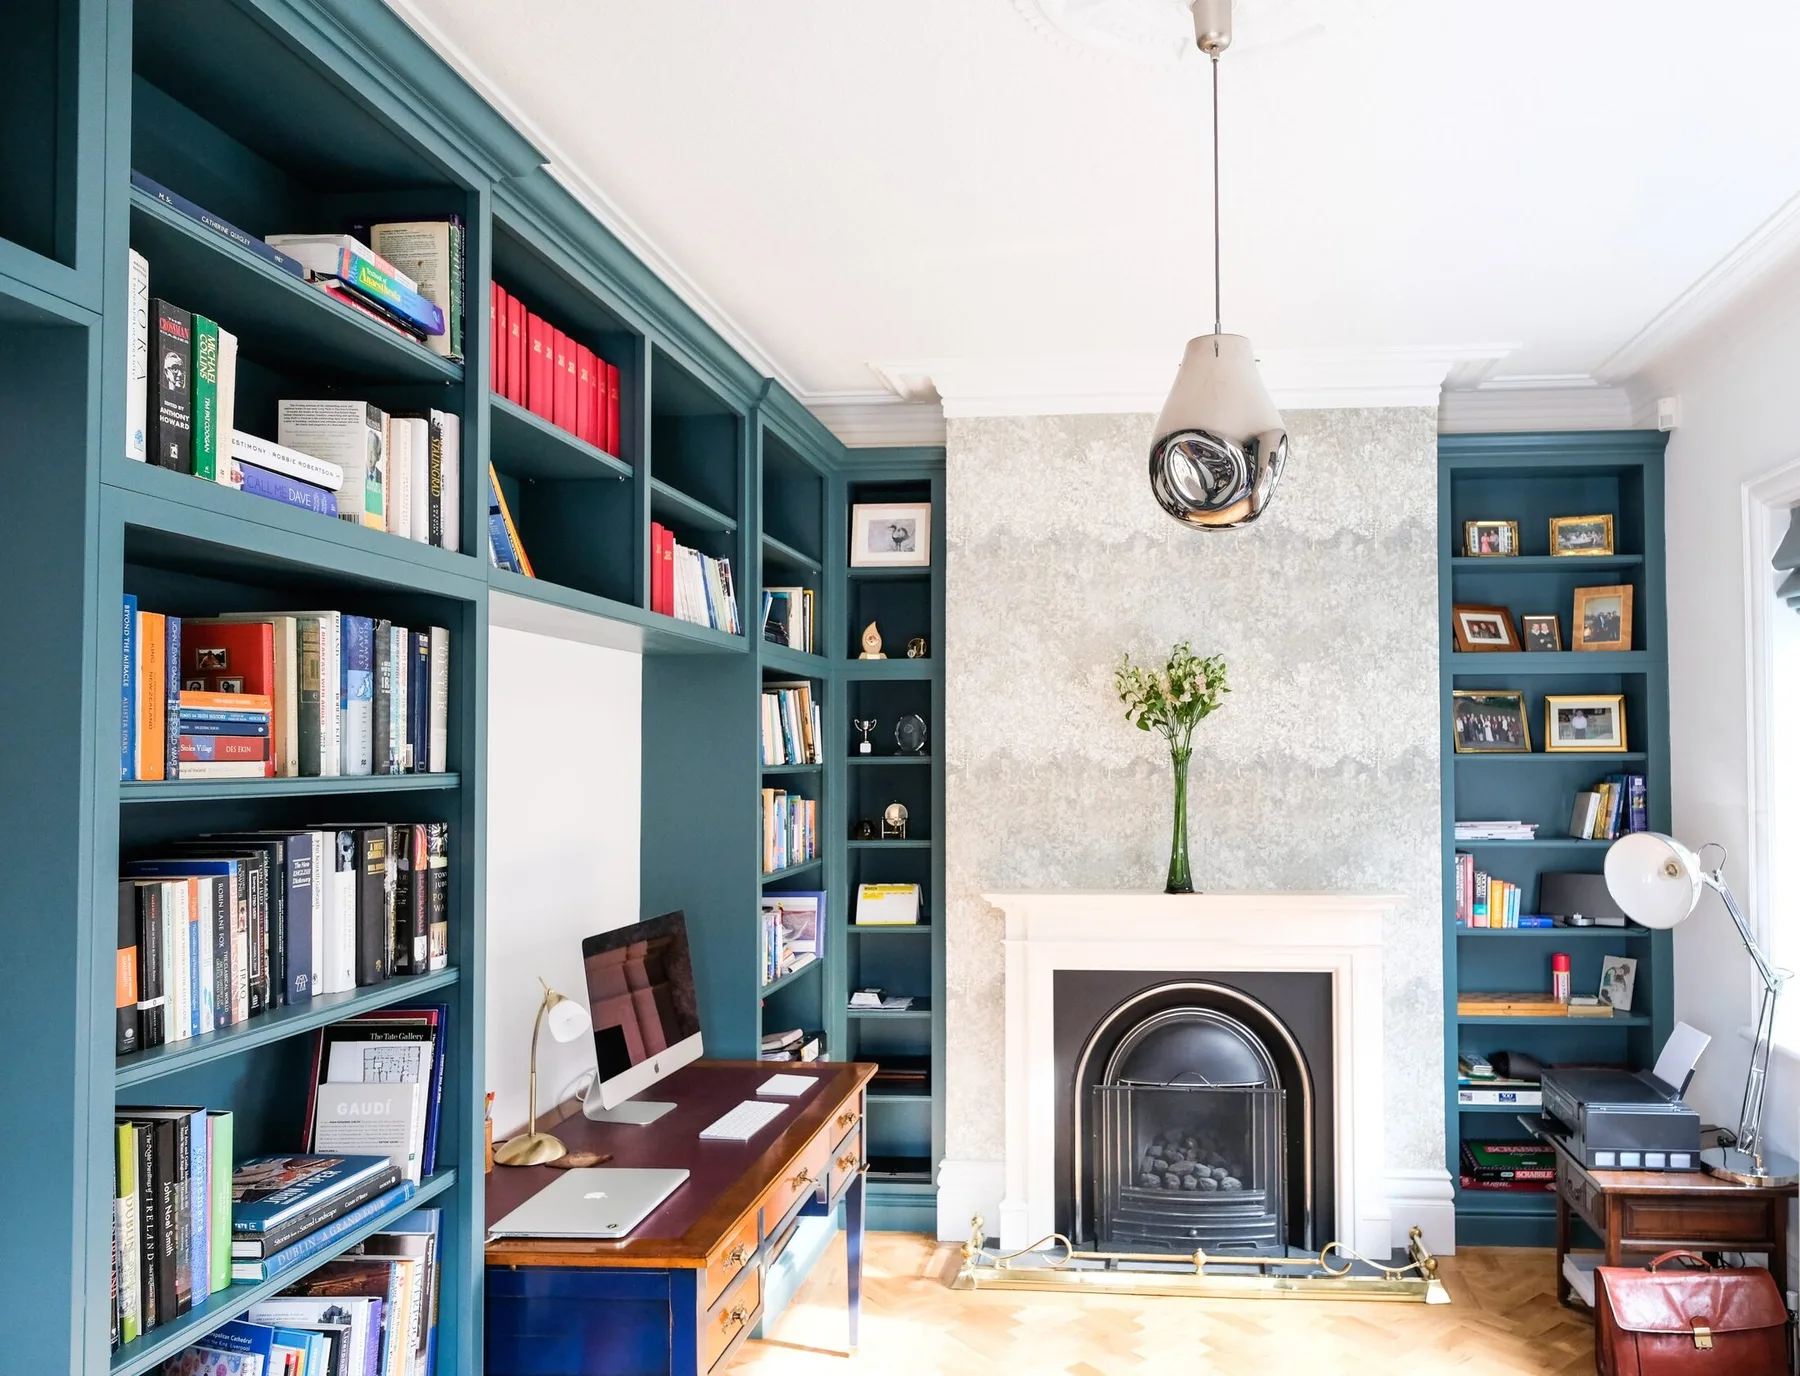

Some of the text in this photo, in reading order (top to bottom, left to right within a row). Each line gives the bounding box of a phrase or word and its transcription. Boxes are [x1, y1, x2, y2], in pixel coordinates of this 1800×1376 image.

[201, 215, 251, 246] CATHERINE QUIGLEY
[359, 267, 401, 302] Anaesthesia
[366, 267, 382, 282] Textbook
[137, 279, 147, 380] NORA
[160, 317, 190, 340] CROSSMAN
[168, 316, 182, 325] THE
[199, 333, 208, 380] COLLINS
[207, 334, 216, 384] MICHAEL
[160, 406, 190, 422] ANTHONY
[164, 400, 177, 409] EDITED
[160, 415, 190, 430] HOWARD
[231, 438, 267, 454] ESTIMONY
[272, 451, 296, 465] ROBBIE
[298, 460, 334, 477] ROBERTSON
[431, 436, 441, 498] STALINGRAD
[246, 475, 273, 495] CALL
[274, 484, 288, 499] ME
[288, 488, 311, 507] DAVE
[437, 646, 446, 711] ULSTER
[170, 747, 178, 766] WAR
[180, 744, 196, 752] Stolen
[196, 744, 213, 754] Village
[225, 745, 237, 753] DES
[292, 868, 312, 877] ENGLISH
[292, 877, 311, 885] Dictionary
[217, 882, 226, 948] ROBIN LANE FOX
[239, 968, 247, 1000] IRAQ
[370, 1032, 424, 1042] The Tate Gallery
[337, 1098, 393, 1116] GAUDÍ
[1486, 1145, 1555, 1153] SCRABBLE
[263, 1186, 305, 1205] JOHN
[301, 1169, 343, 1189] PIPER
[1515, 1171, 1554, 1179] SCRABBLE
[126, 1195, 135, 1247] DUBLIN
[145, 1197, 155, 1262] IRELAND
[163, 1181, 174, 1257] John Noel Smith
[273, 1233, 291, 1247] Stories
[299, 1218, 316, 1233] Sacred
[314, 1207, 338, 1224] Landscape
[277, 1237, 316, 1266] DUBLIN
[322, 1232, 329, 1241] A
[329, 1215, 361, 1237] GRAND
[360, 1199, 386, 1216] TOUR
[411, 1263, 423, 1349] LIVERPOOL
[229, 1341, 251, 1352] Liverpool
[230, 1334, 253, 1344] Cathedral
[340, 1330, 349, 1373] Liverpool
